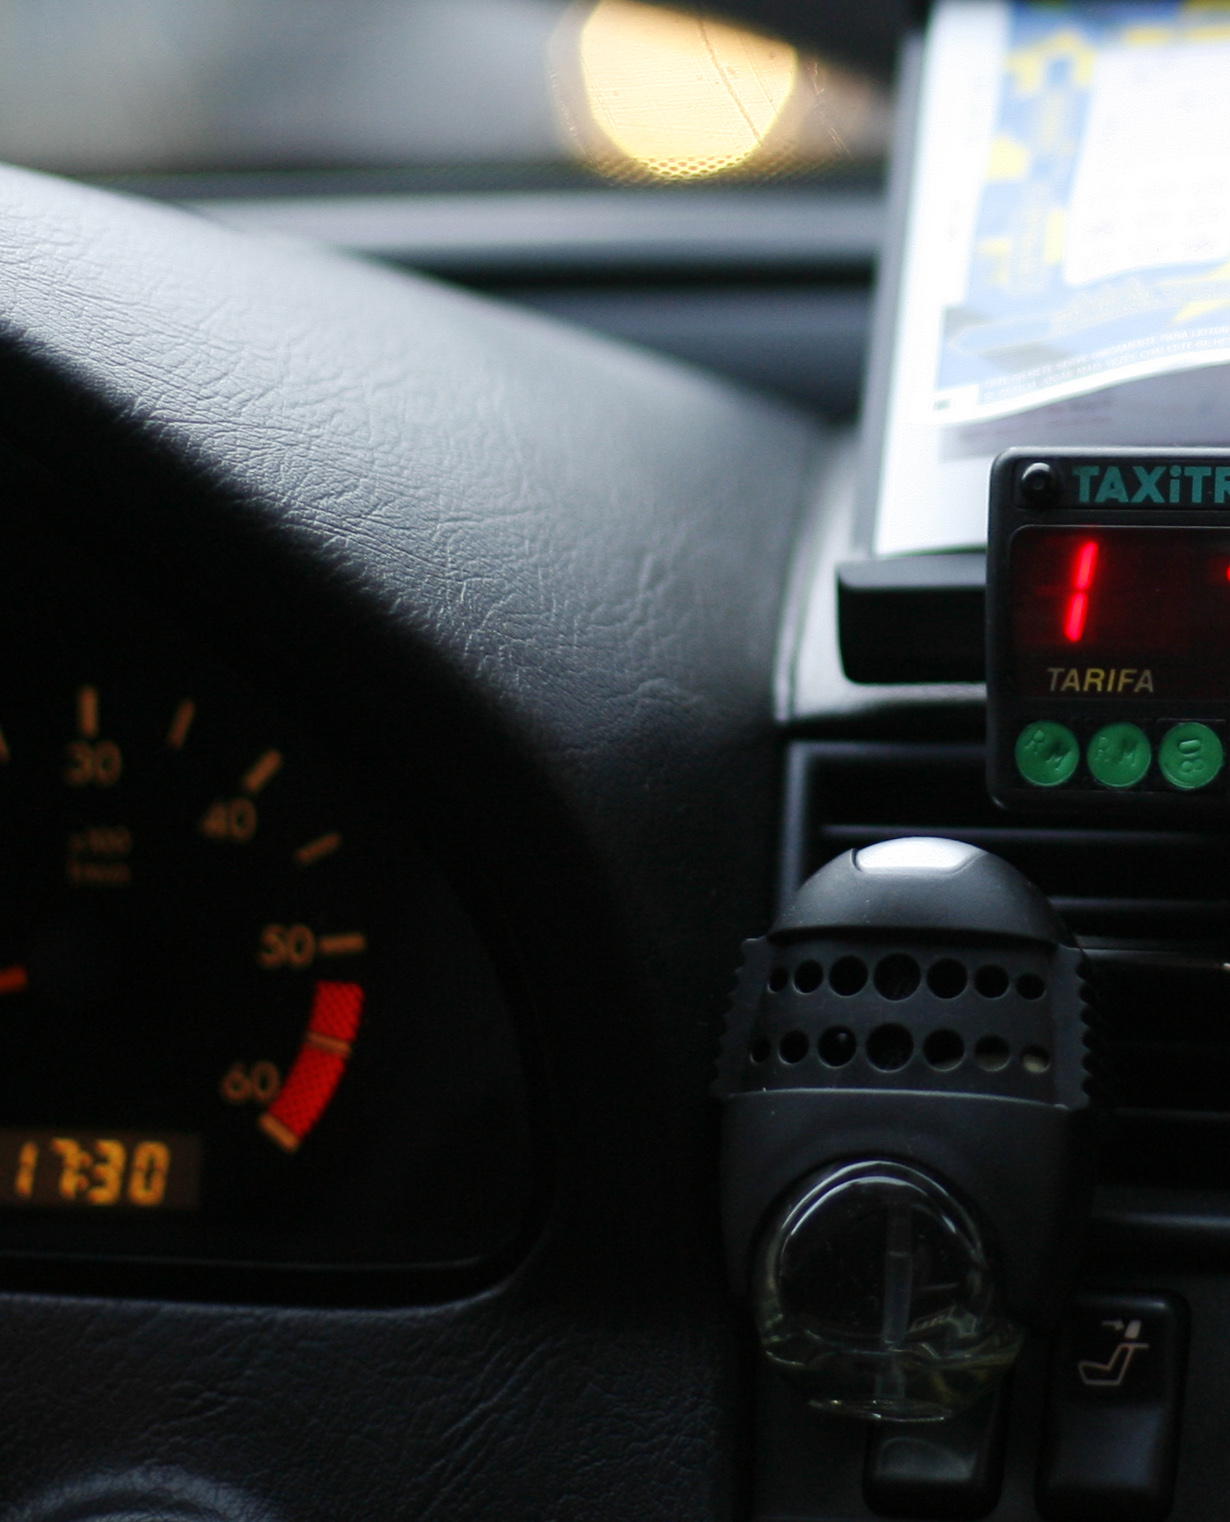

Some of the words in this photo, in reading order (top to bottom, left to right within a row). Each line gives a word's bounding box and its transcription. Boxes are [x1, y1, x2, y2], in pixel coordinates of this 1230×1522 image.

[1064, 540, 1099, 643] 1
[1047, 667, 1156, 693] TARIFA
[66, 740, 122, 786] 30
[202, 799, 257, 842] 40
[259, 924, 315, 967] 50
[221, 1061, 281, 1102] 60
[16, 1138, 170, 1206] 17:30
